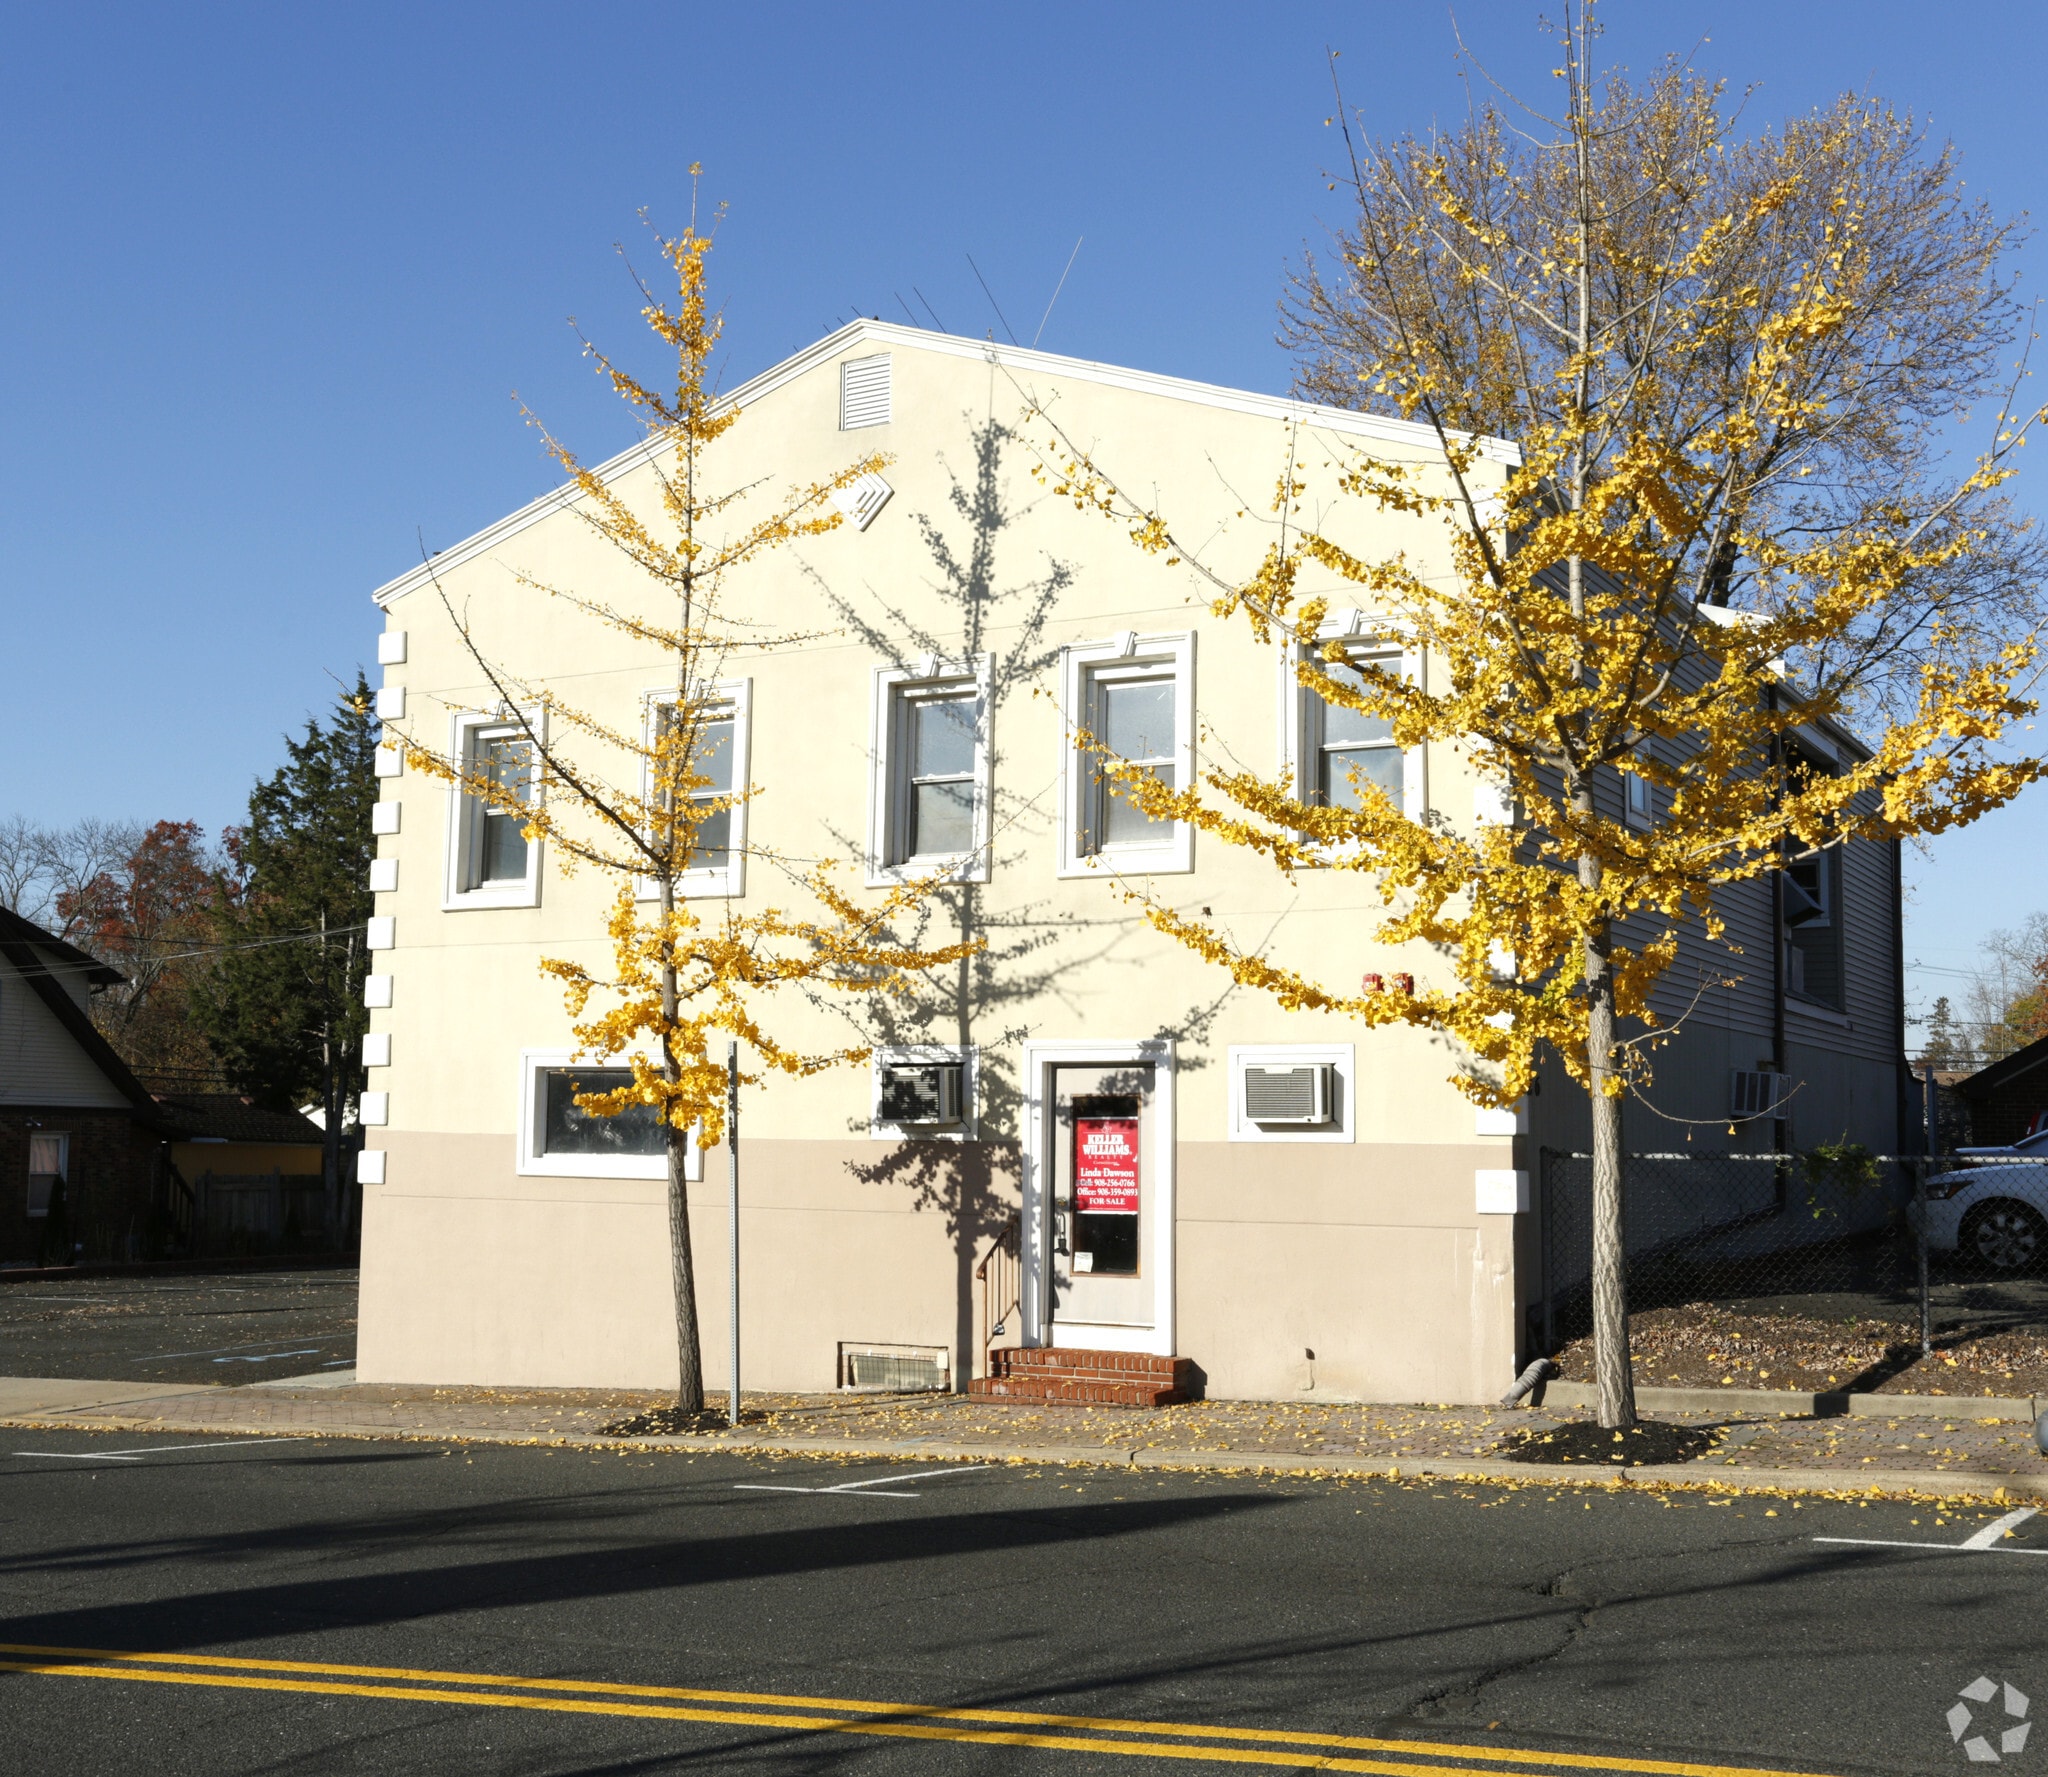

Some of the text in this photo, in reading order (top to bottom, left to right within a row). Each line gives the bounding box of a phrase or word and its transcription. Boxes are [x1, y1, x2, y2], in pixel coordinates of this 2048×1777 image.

[1088, 1134, 1124, 1144] KELLER
[1083, 1145, 1130, 1155] WILLIAMS
[1081, 1168, 1135, 1177] Linda Dawson
[1077, 1187, 1096, 1196] Office:
